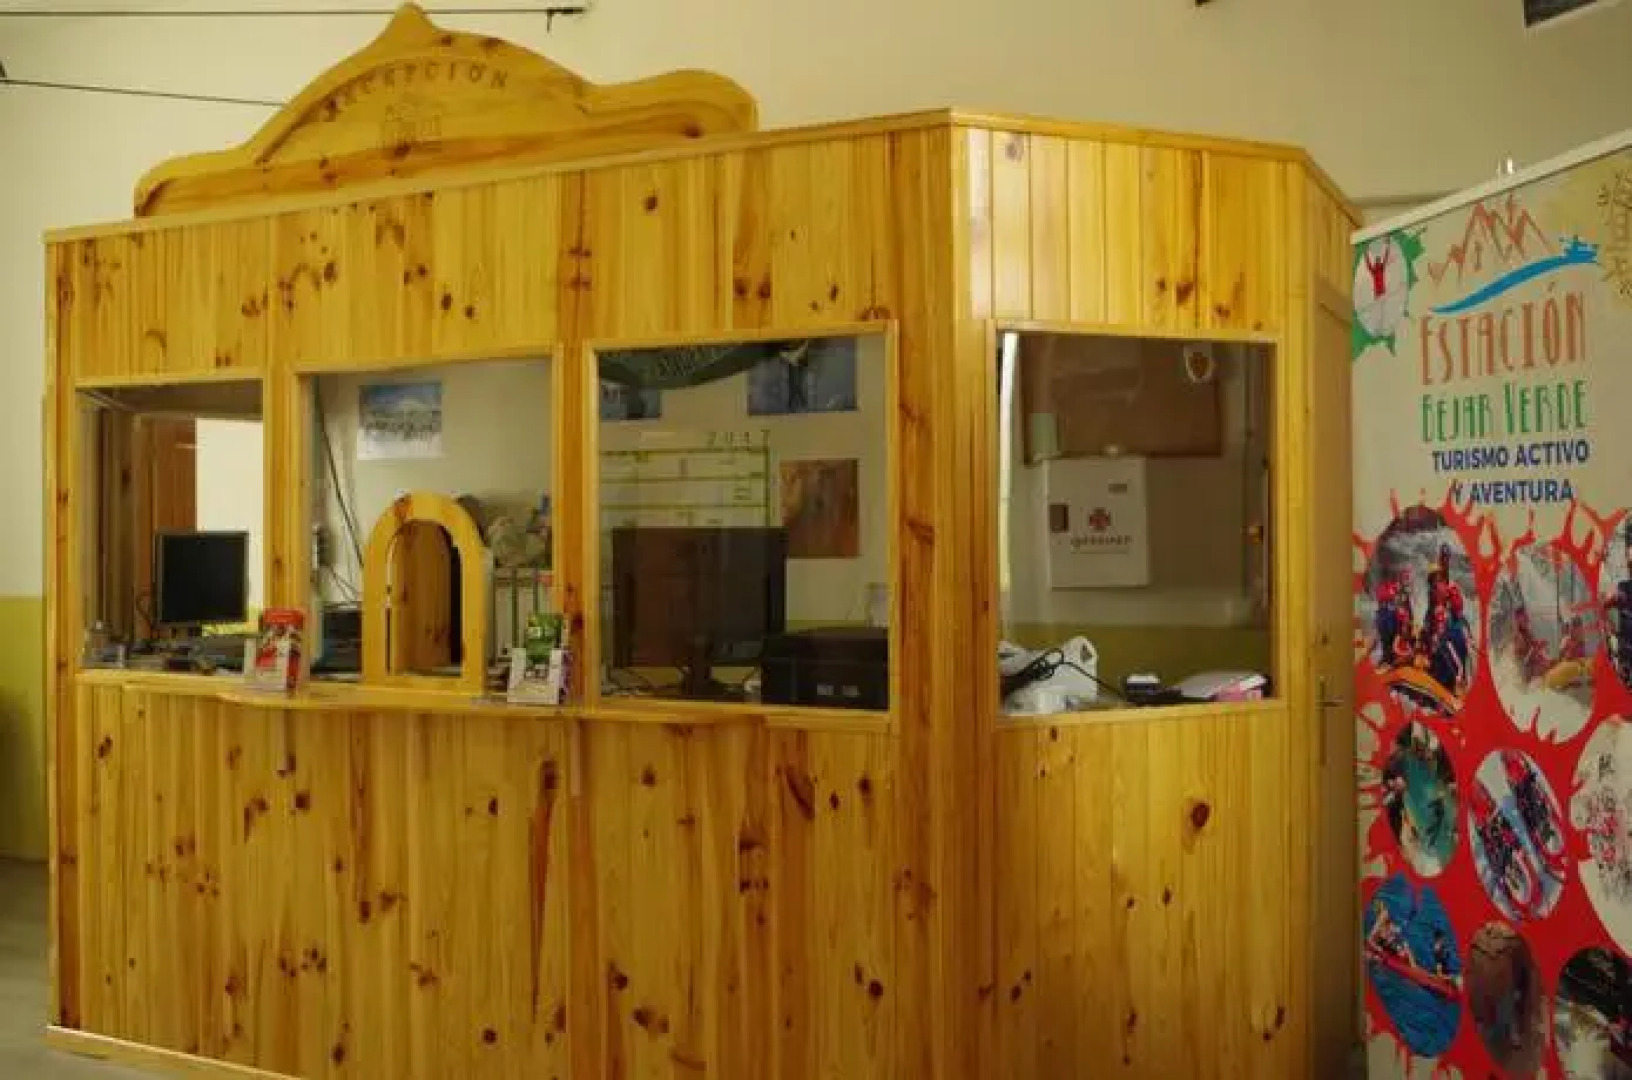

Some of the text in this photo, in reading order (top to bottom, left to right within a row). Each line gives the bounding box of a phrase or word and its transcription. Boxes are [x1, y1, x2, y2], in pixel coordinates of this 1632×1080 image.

[1420, 281, 1586, 386] ESTACIÓN
[1504, 380, 1587, 435] VERDE
[1432, 438, 1590, 473] TURISMO ACTIVO
[1452, 478, 1574, 504] Y AVENTURA
